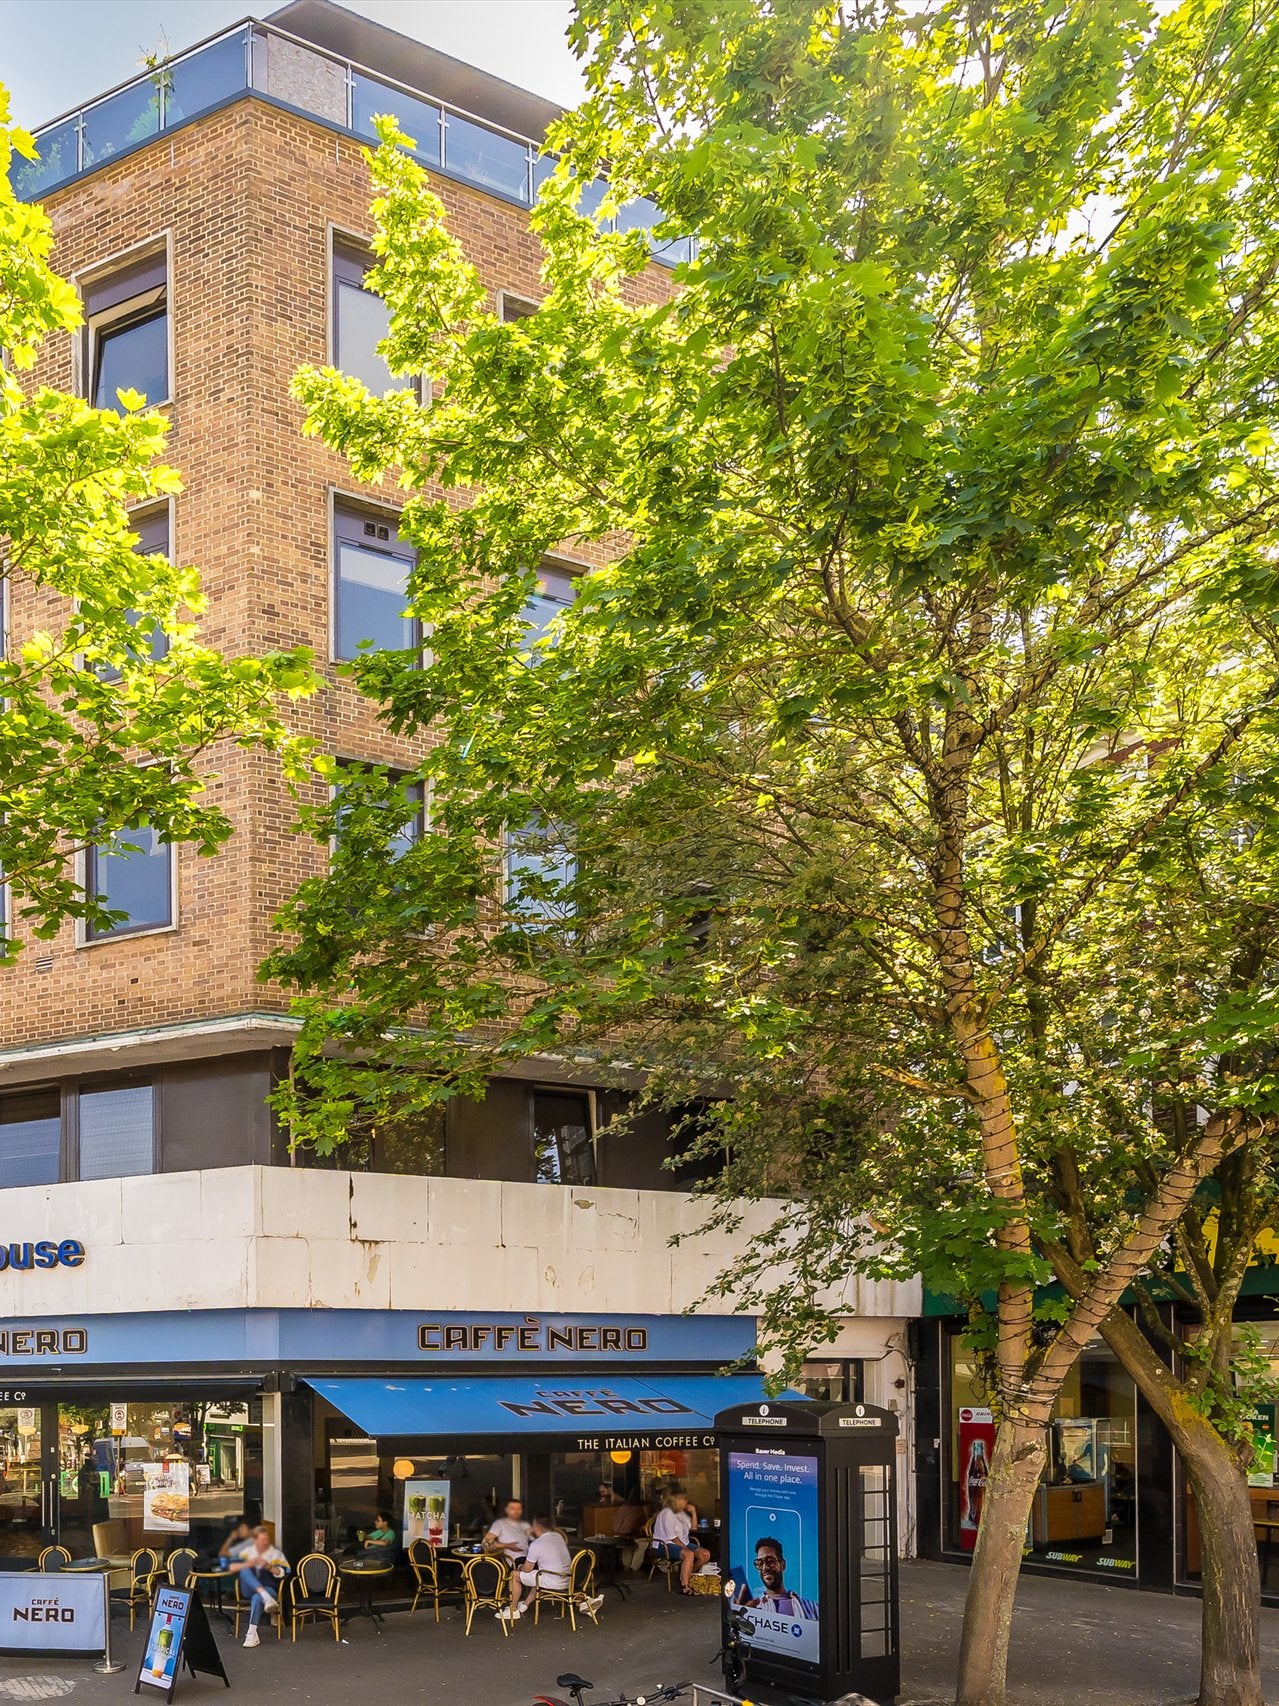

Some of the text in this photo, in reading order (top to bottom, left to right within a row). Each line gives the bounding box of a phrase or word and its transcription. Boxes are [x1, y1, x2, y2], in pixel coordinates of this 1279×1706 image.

[417, 1316, 649, 1352] CAFFÈ NERO
[497, 1398, 696, 1418] NERO
[747, 1418, 785, 1426] TELEPHONE
[577, 1439, 599, 1450] THE
[605, 1438, 650, 1449] ITALIAN
[655, 1436, 699, 1448] COFFEE
[736, 1460, 811, 1473] Spend. Save. Invest.
[743, 1471, 802, 1485] All in one place.
[407, 1511, 446, 1520] MATCHA
[1045, 1551, 1083, 1563] SUBWAY
[1096, 1557, 1136, 1569] SUBWAY
[31, 1597, 60, 1606] CAFFÈ
[161, 1598, 185, 1611] NERO
[13, 1607, 75, 1623] NERO
